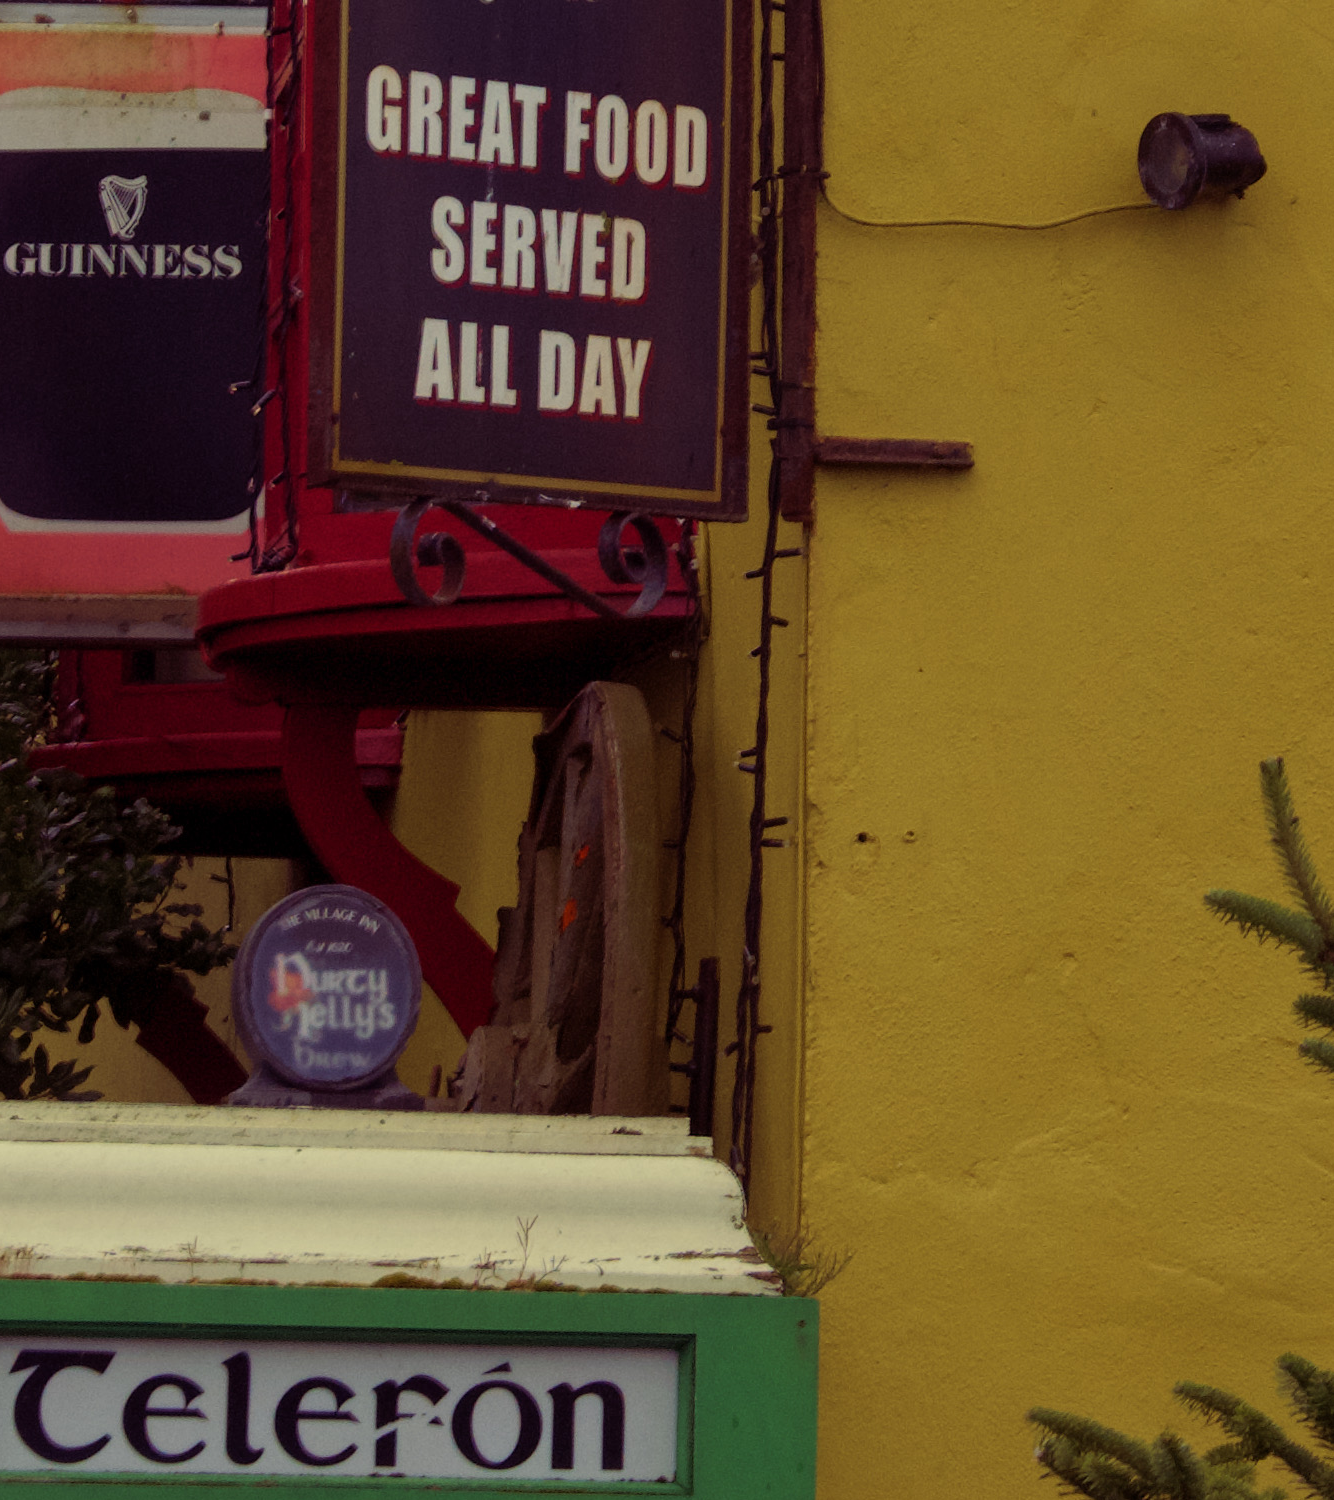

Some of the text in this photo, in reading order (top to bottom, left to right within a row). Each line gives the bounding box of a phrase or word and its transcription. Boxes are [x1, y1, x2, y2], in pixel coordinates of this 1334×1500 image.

[364, 63, 709, 190] GREAT FOOD
[3, 242, 243, 279] GUINNESS
[430, 196, 648, 302] SERVED
[413, 317, 652, 420] ALL DAY
[305, 907, 358, 922] VILLAGE
[7, 1349, 626, 1472] Telefón
